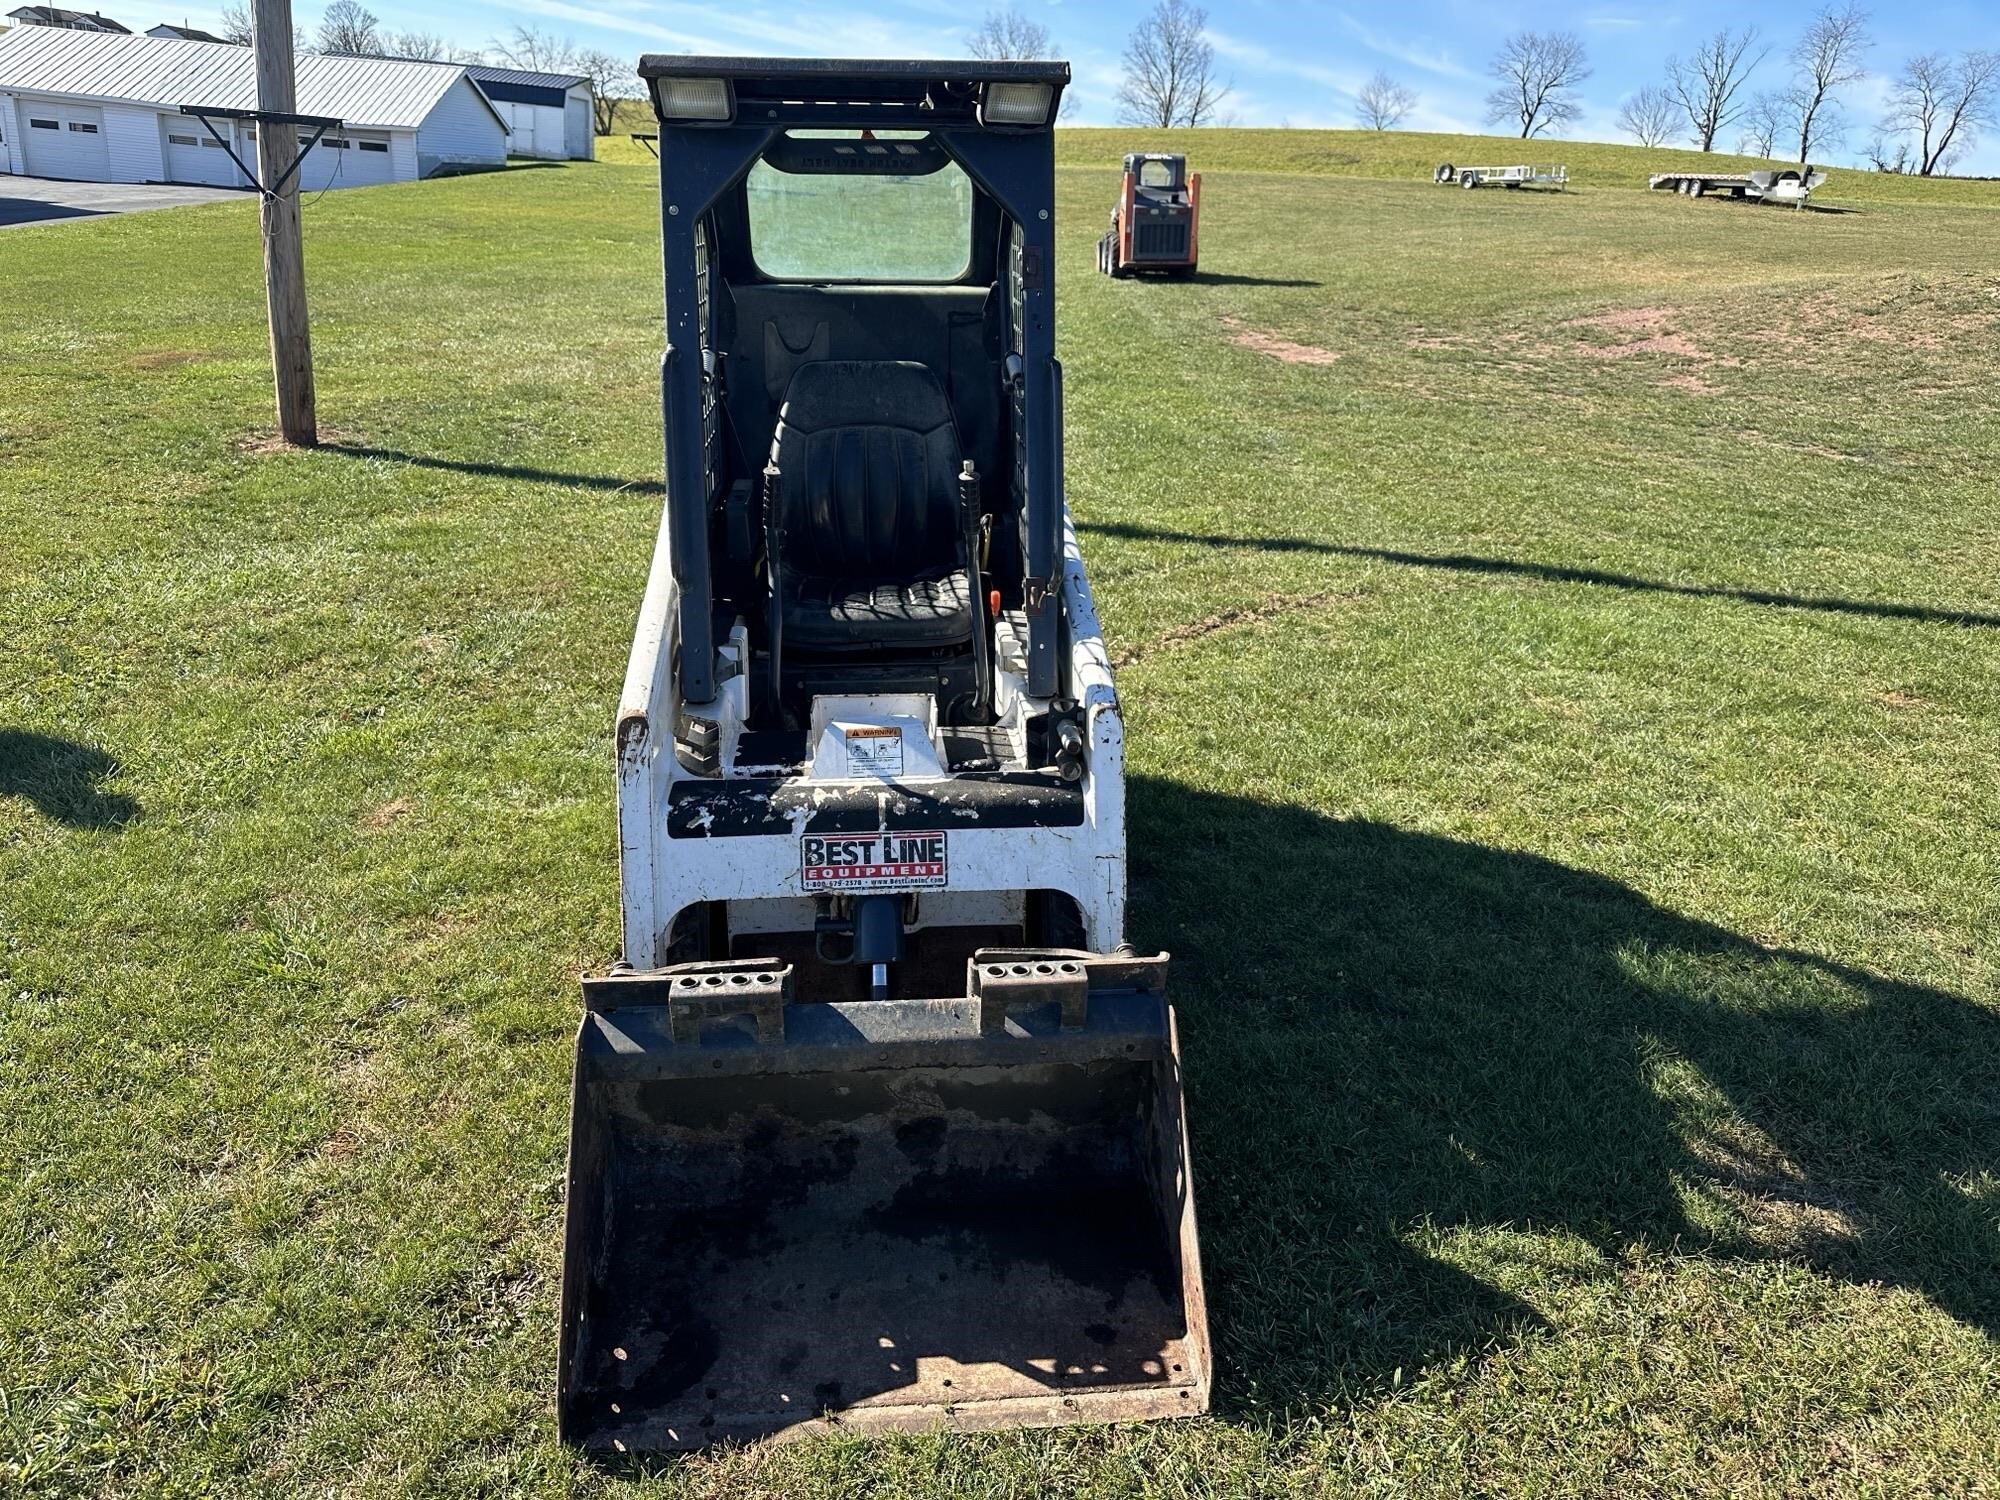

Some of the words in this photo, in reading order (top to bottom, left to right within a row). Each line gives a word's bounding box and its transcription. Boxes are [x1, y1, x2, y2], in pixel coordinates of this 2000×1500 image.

[805, 839, 876, 866] BEST
[883, 836, 943, 863] LINE
[809, 865, 940, 878] EQUIPMENT
